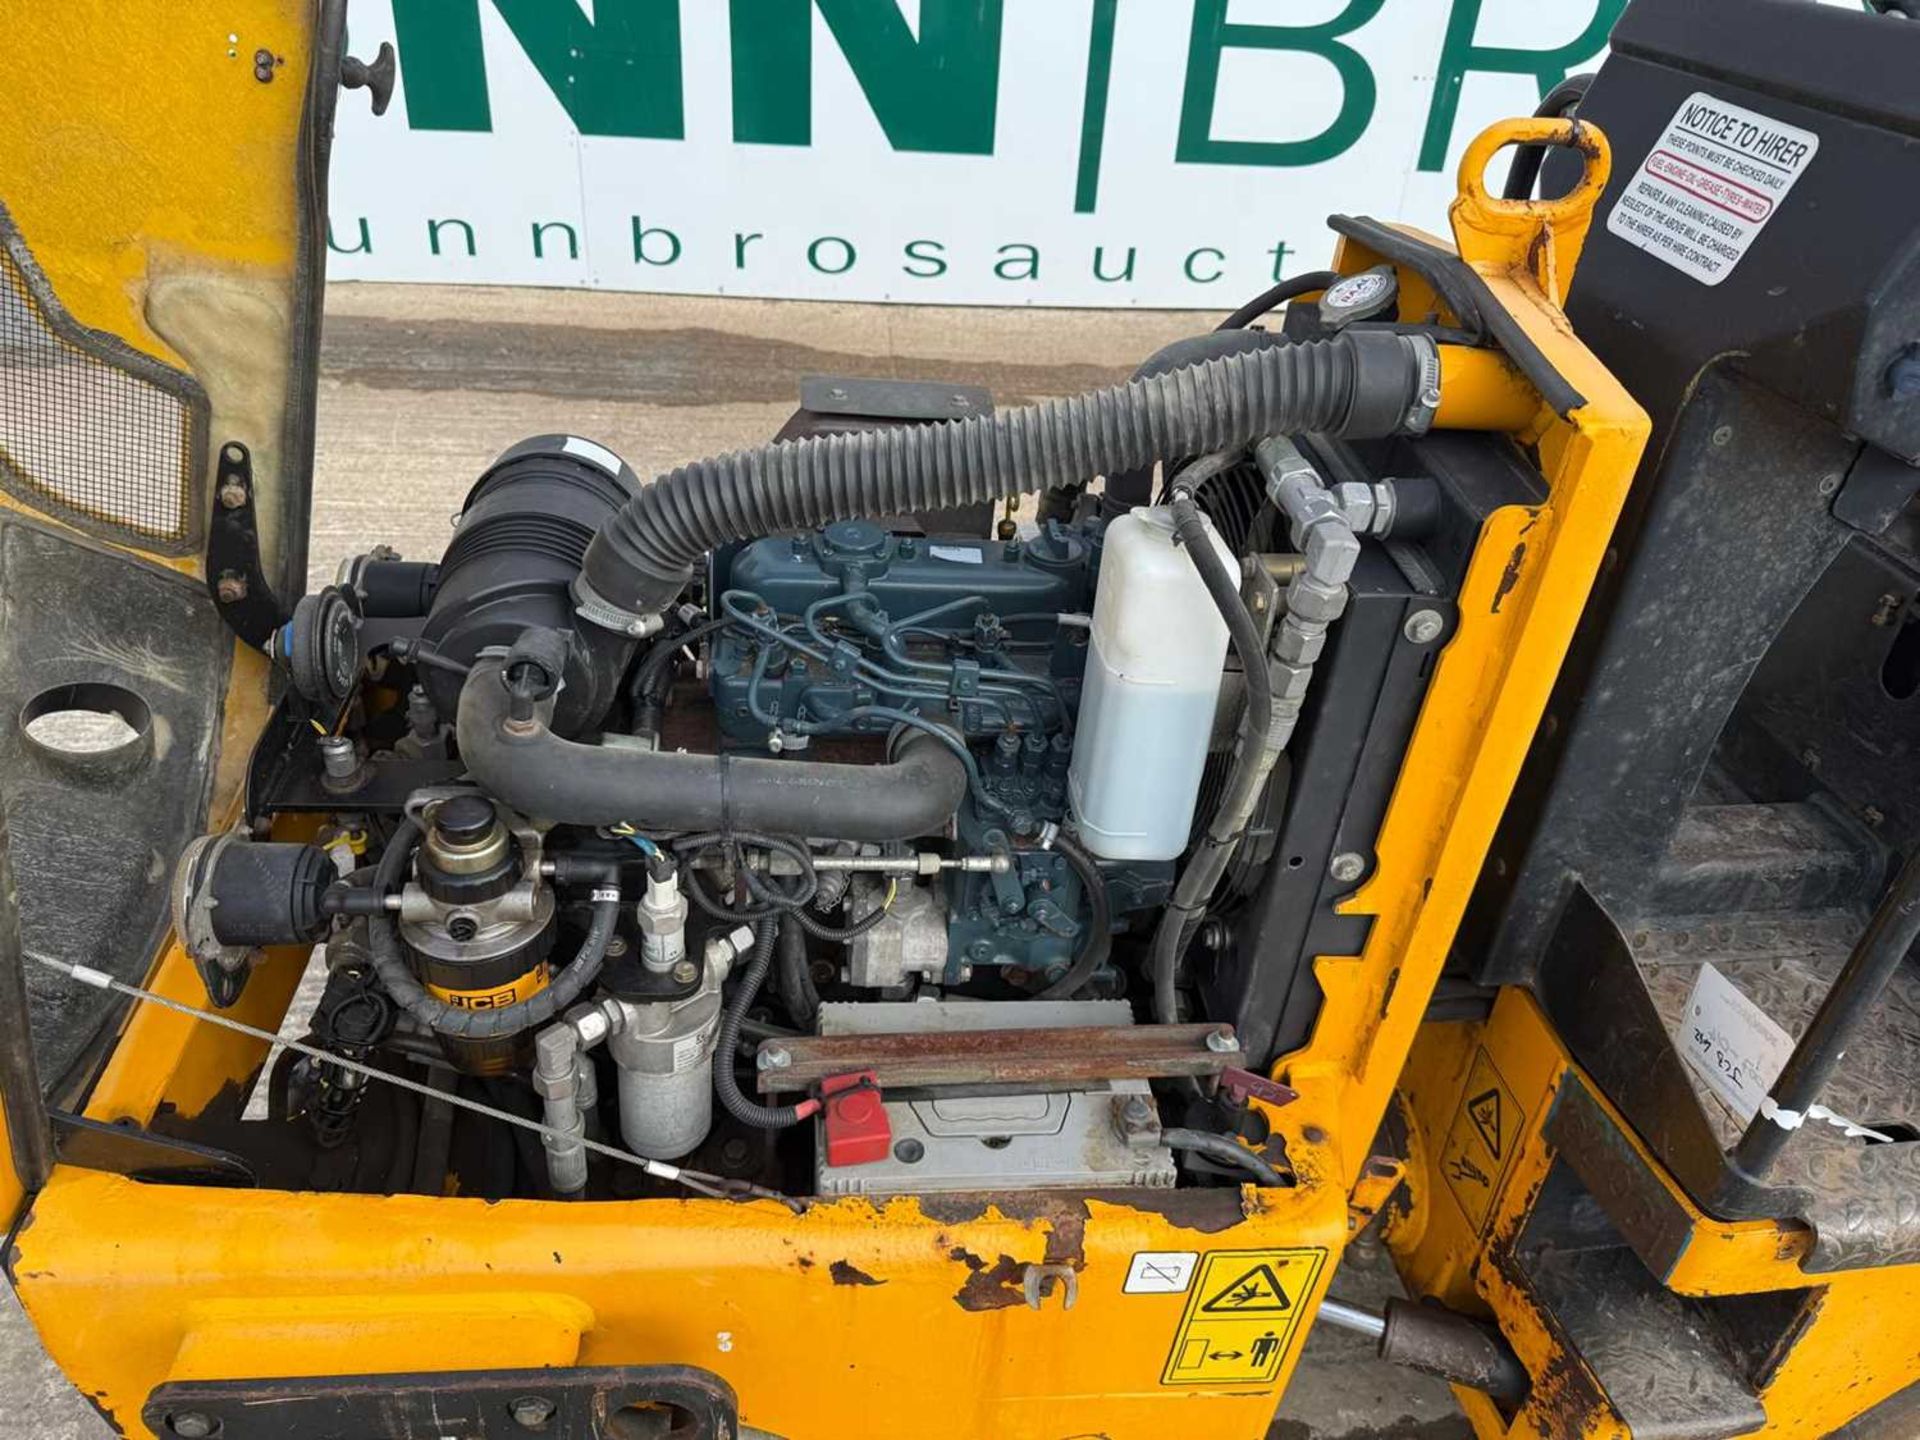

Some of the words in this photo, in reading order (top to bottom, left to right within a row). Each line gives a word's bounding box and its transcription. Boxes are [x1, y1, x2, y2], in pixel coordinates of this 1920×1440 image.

[1666, 133, 1687, 148] THESE
[1684, 141, 1707, 158] POINTS
[1705, 150, 1725, 165] MUST
[1722, 157, 1734, 169] BE
[1732, 162, 1765, 182] CHECKED
[1763, 174, 1785, 190] DAILY
[1680, 103, 1738, 139] NOTICE
[1730, 122, 1760, 148] TO
[1752, 131, 1809, 167] HIRER
[1623, 195, 1647, 213] NEGLECT
[1645, 206, 1655, 217] OF
[1653, 210, 1666, 223] THE
[1664, 216, 1685, 233] ABOVE
[1684, 226, 1700, 241] WILL
[1698, 234, 1709, 245] BE
[1707, 238, 1739, 261] CHARGED
[1638, 182, 1662, 201] REPAIRS
[1665, 196, 1679, 209] ANY
[1677, 201, 1709, 223] CLEANING
[1707, 216, 1733, 236] CAUSED
[1731, 229, 1743, 240] BY
[1617, 213, 1626, 224] TO
[1625, 216, 1637, 228] THE
[1636, 222, 1654, 237] HIRER
[1660, 234, 1673, 248] PER
[1672, 241, 1688, 256] HIRE
[1686, 249, 1720, 273] CONTRACT
